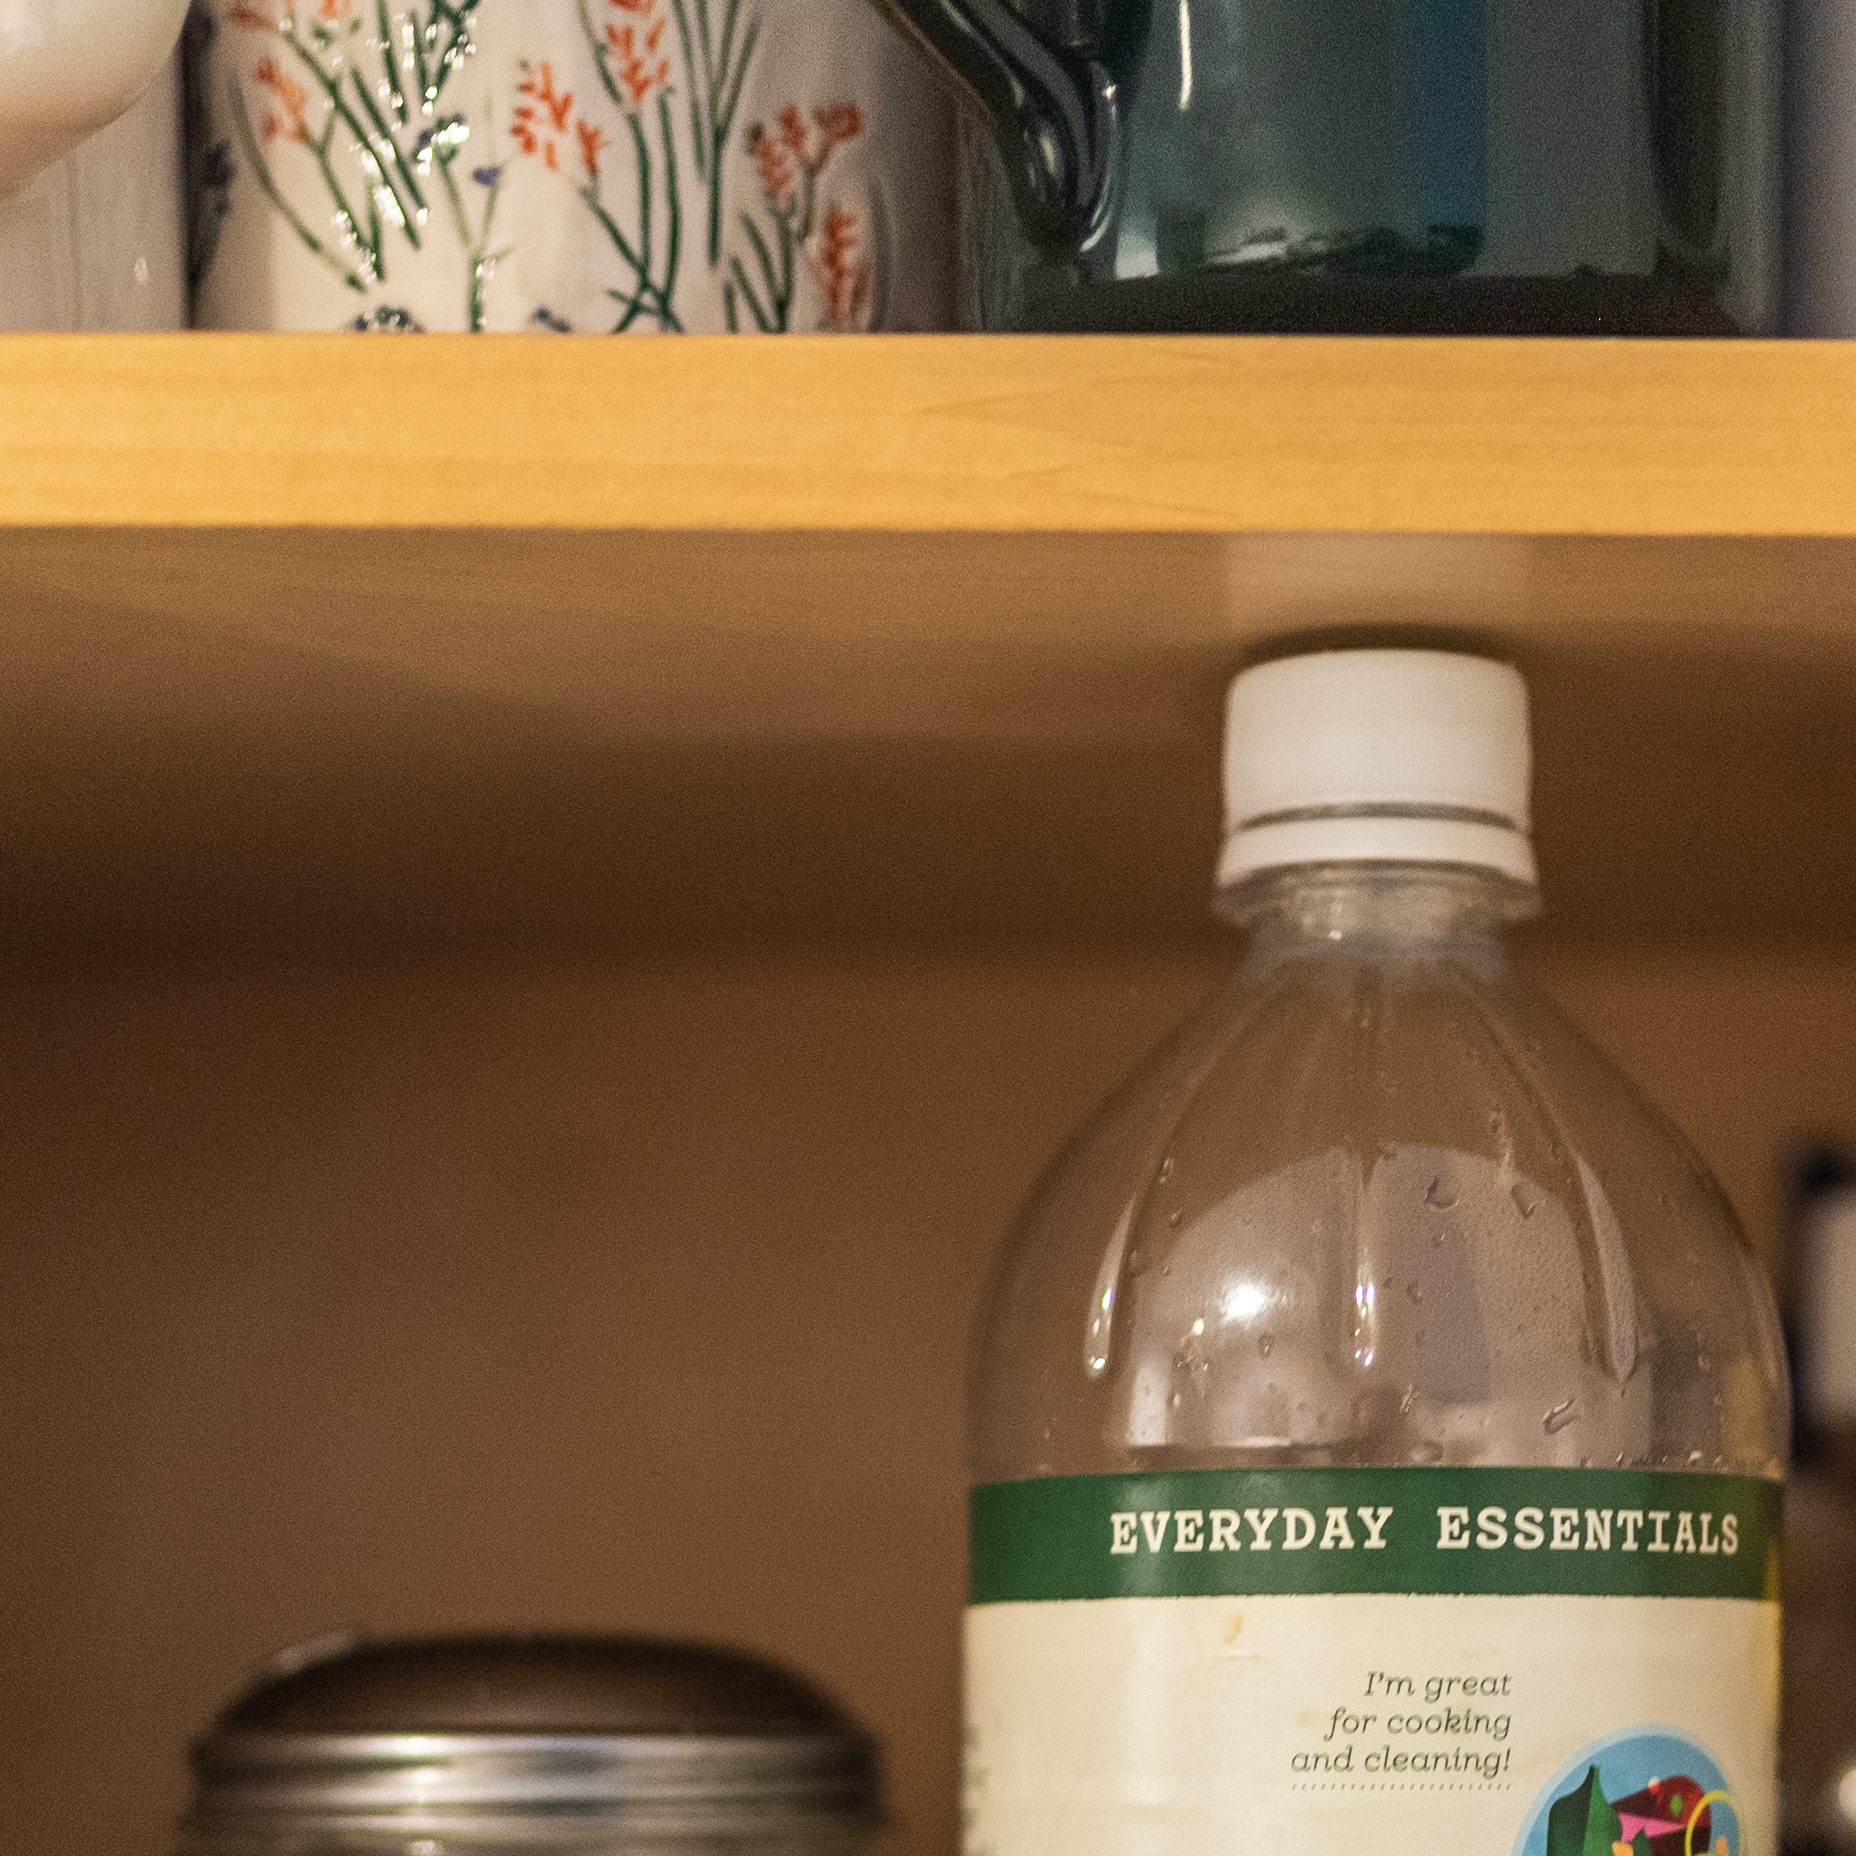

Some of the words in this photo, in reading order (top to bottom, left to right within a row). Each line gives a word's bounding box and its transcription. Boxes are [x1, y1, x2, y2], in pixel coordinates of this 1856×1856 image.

[1110, 1507, 1393, 1555] EVERYDAY
[1436, 1506, 1738, 1554] ESSENTIALS
[1364, 1671, 1415, 1697] I'm
[1424, 1674, 1511, 1704] great
[1323, 1706, 1378, 1742] for
[1386, 1706, 1512, 1742] cooking
[1290, 1744, 1354, 1773] and
[1363, 1744, 1512, 1781] cleaning!
